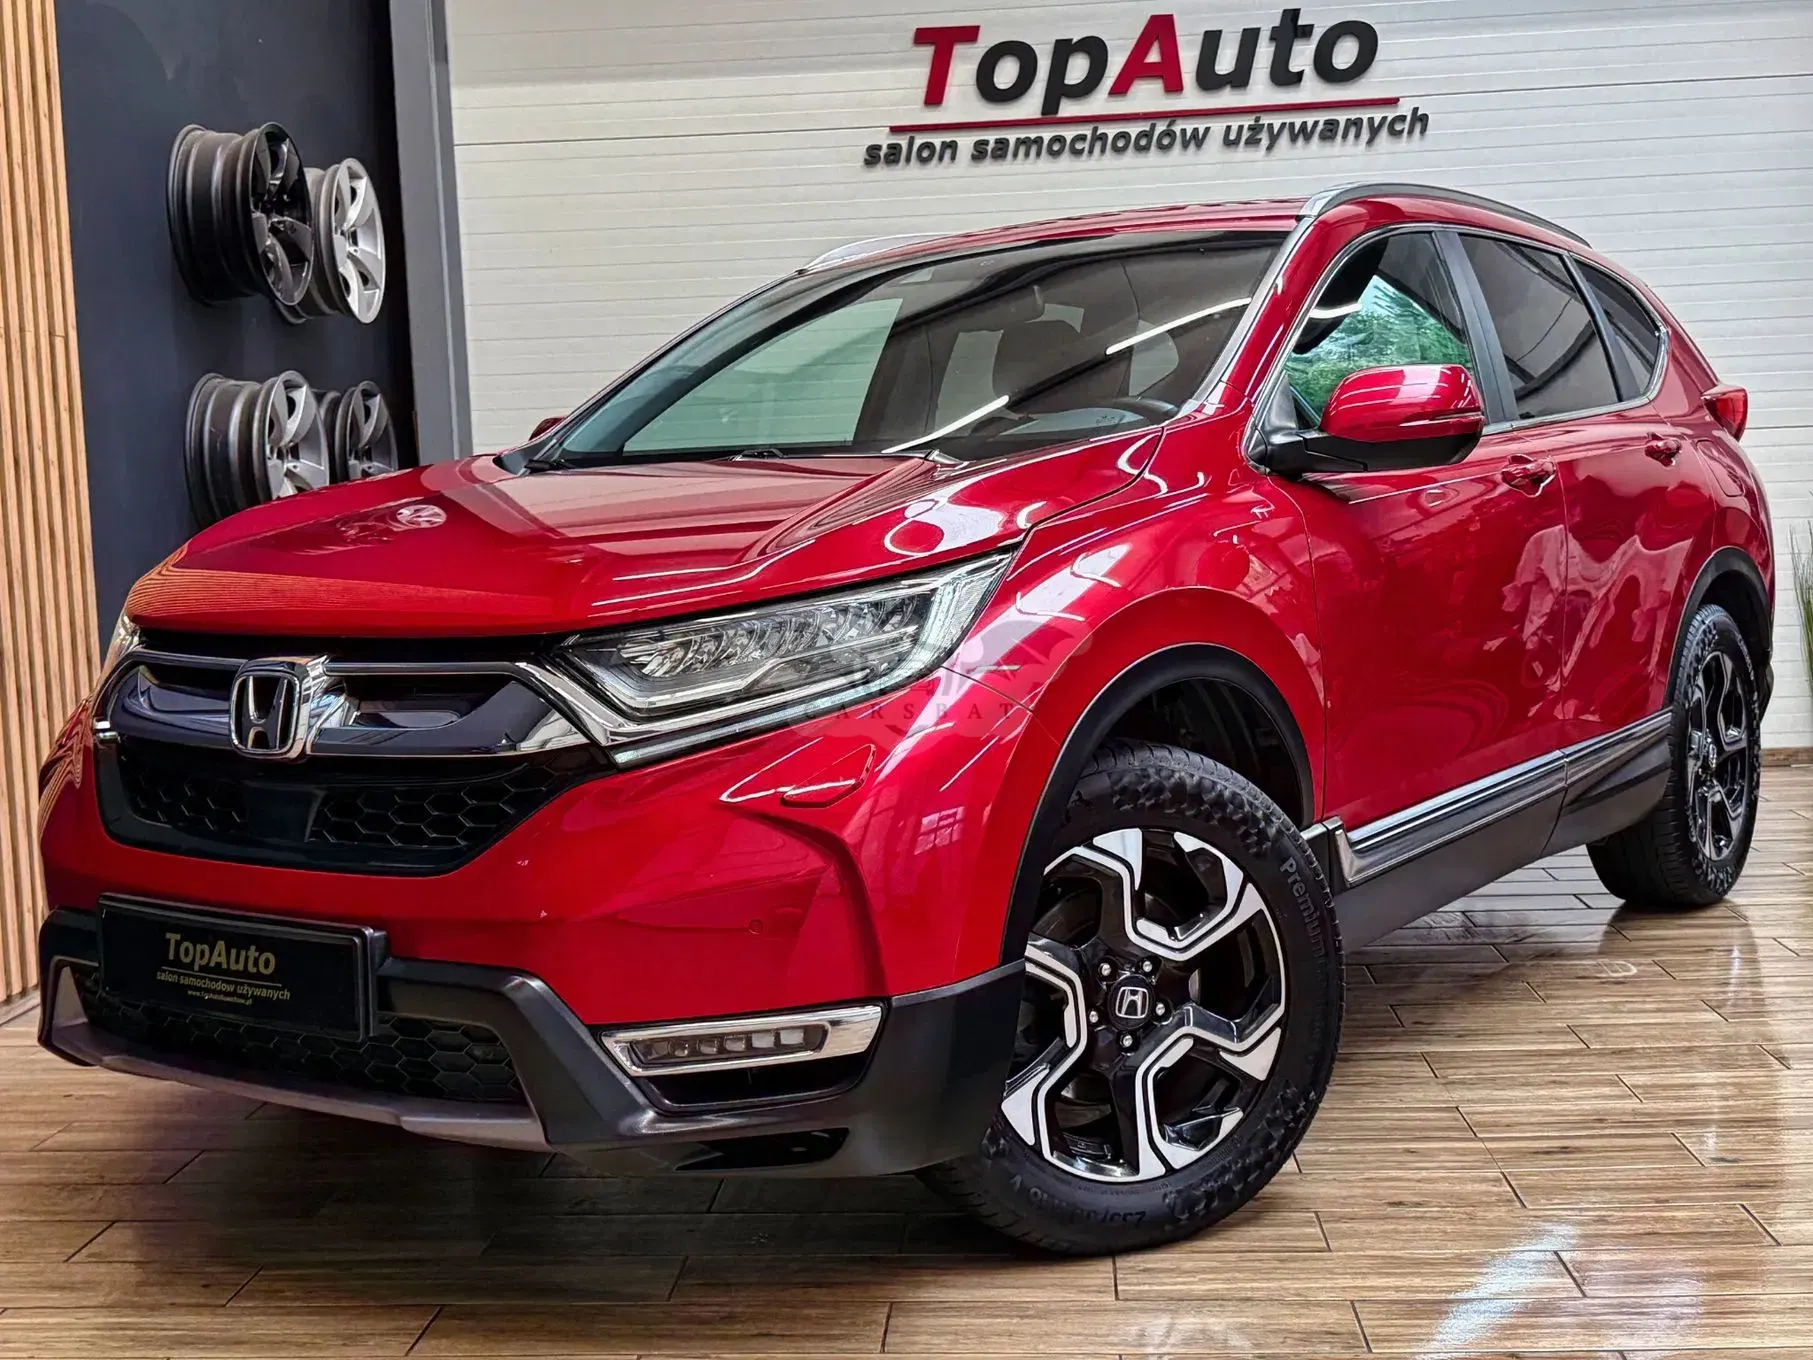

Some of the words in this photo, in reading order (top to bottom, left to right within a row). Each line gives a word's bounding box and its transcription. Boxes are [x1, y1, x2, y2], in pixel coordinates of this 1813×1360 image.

[913, 8, 1379, 116] TopAuto
[863, 136, 958, 167] salon
[970, 118, 1211, 161] samochodów
[1223, 107, 1430, 158] używanych
[165, 932, 276, 975] TopAuto
[156, 971, 178, 983] salon
[237, 984, 291, 1001] używanych
